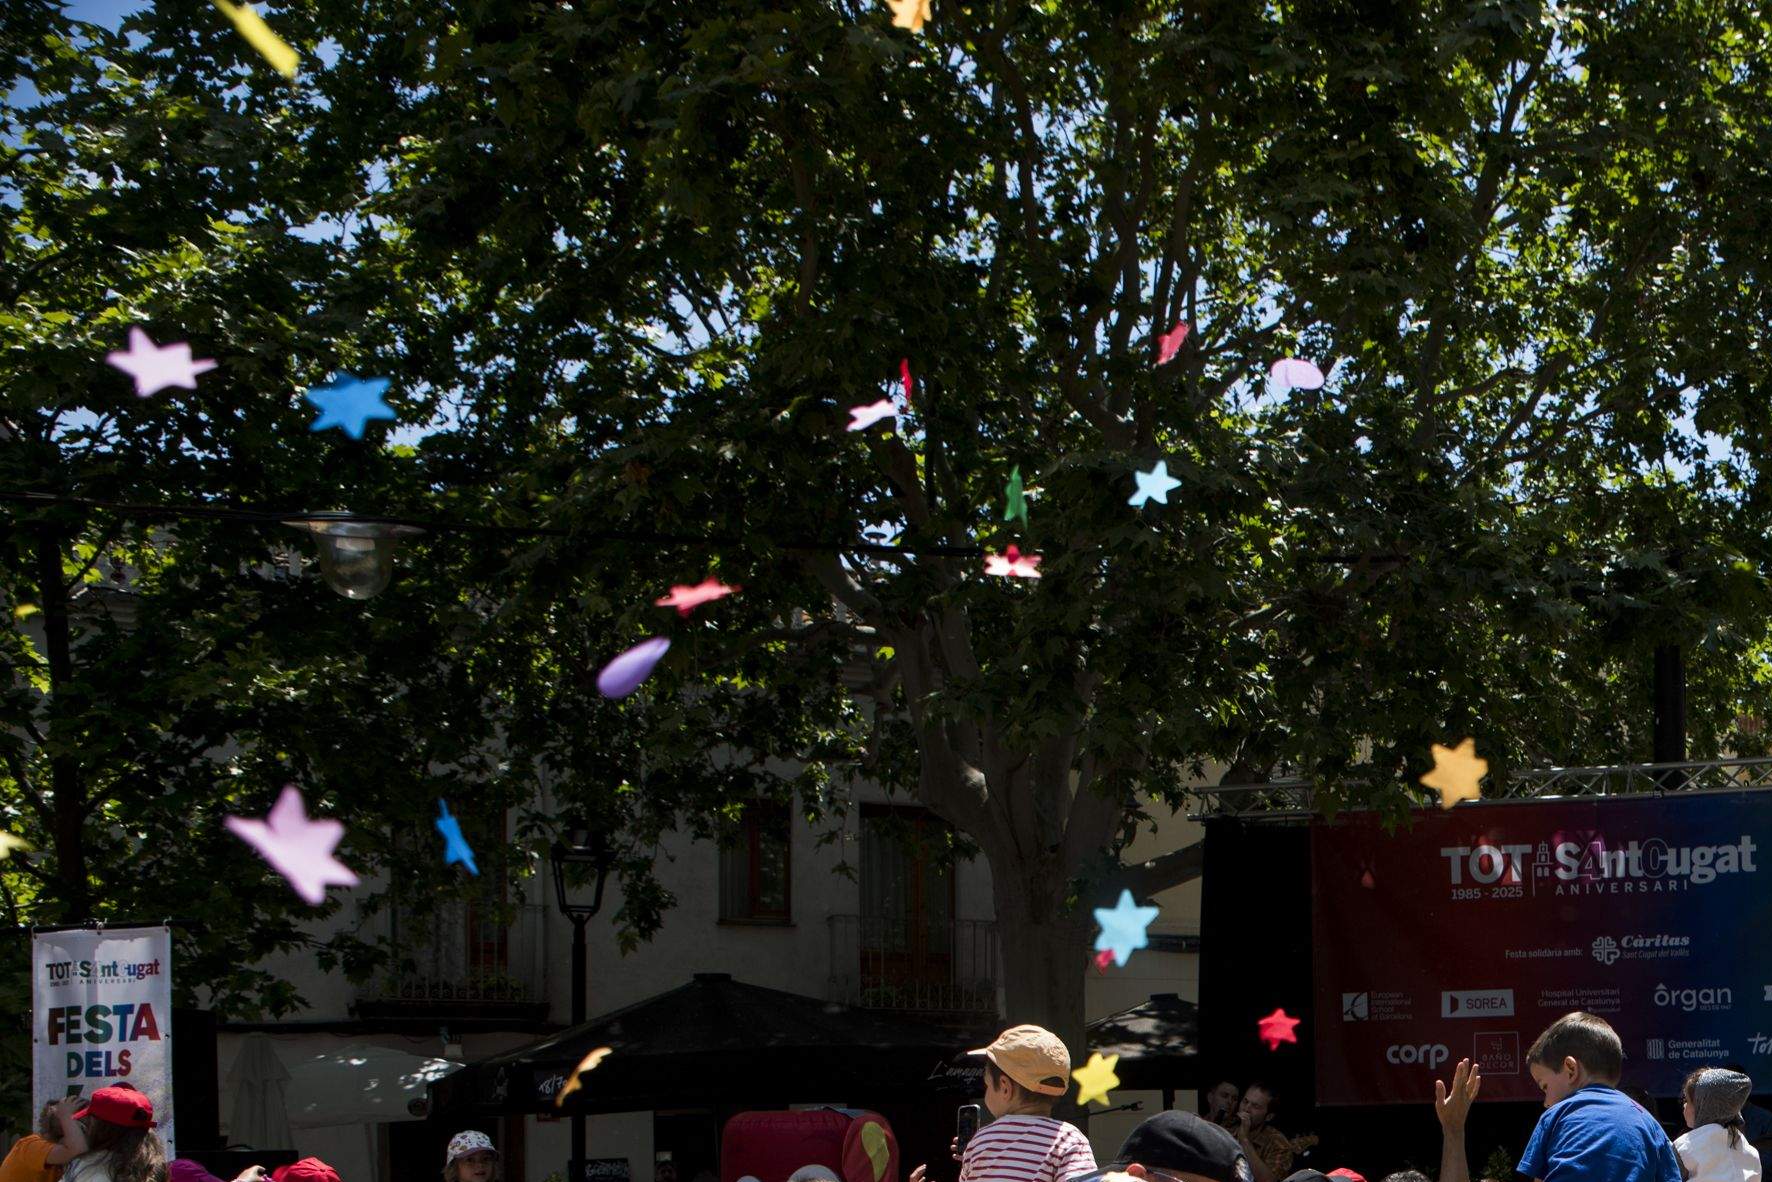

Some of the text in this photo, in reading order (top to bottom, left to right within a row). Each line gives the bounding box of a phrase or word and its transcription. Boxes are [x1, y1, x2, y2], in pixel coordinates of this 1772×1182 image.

[1440, 843, 1532, 885] TOT
[1452, 888, 1480, 900] 1985
[1491, 886, 1524, 899] 2025
[1556, 879, 1689, 897] ANIVERSARI
[1621, 934, 1690, 948] Càritas
[1505, 948, 1527, 959] Festa
[45, 961, 72, 980] TOT
[1466, 997, 1508, 1009] SOREA
[48, 1003, 161, 1045] FESTA
[1668, 1038, 1720, 1049] Generalitat
[1385, 1043, 1449, 1069] corp
[1668, 1049, 1730, 1060] de Catalunya
[67, 1049, 131, 1078] DELS
